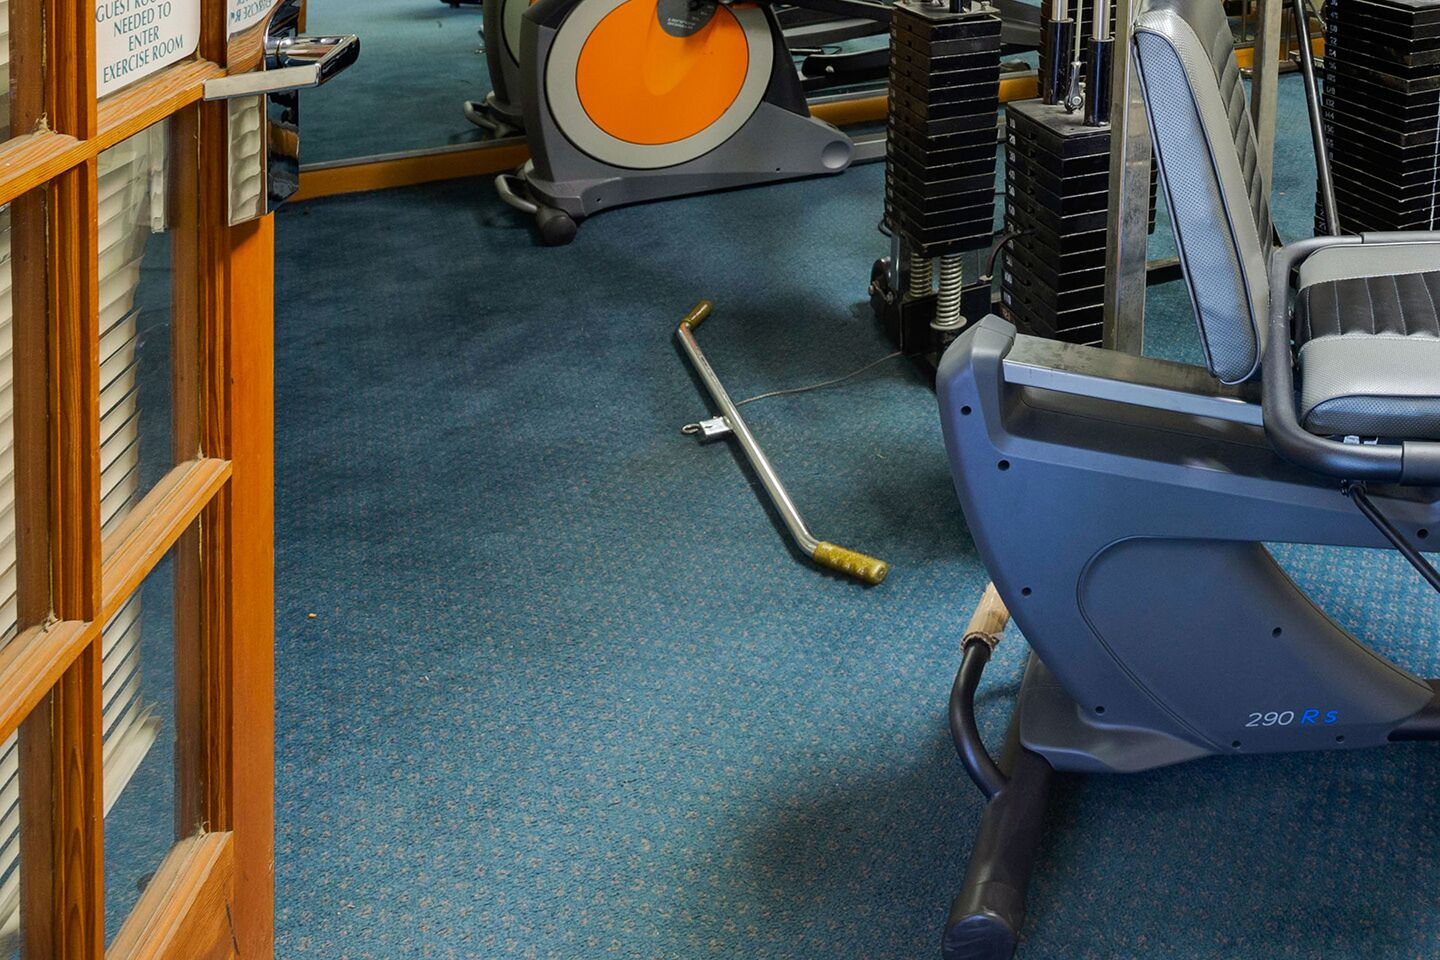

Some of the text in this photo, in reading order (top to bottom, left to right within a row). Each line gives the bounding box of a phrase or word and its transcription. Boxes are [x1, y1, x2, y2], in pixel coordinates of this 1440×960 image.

[113, 1, 172, 38] NEEDED TO
[128, 25, 160, 52] ENTER
[103, 34, 184, 84] EXERCISE ROOM
[1244, 710, 1295, 728] 290
